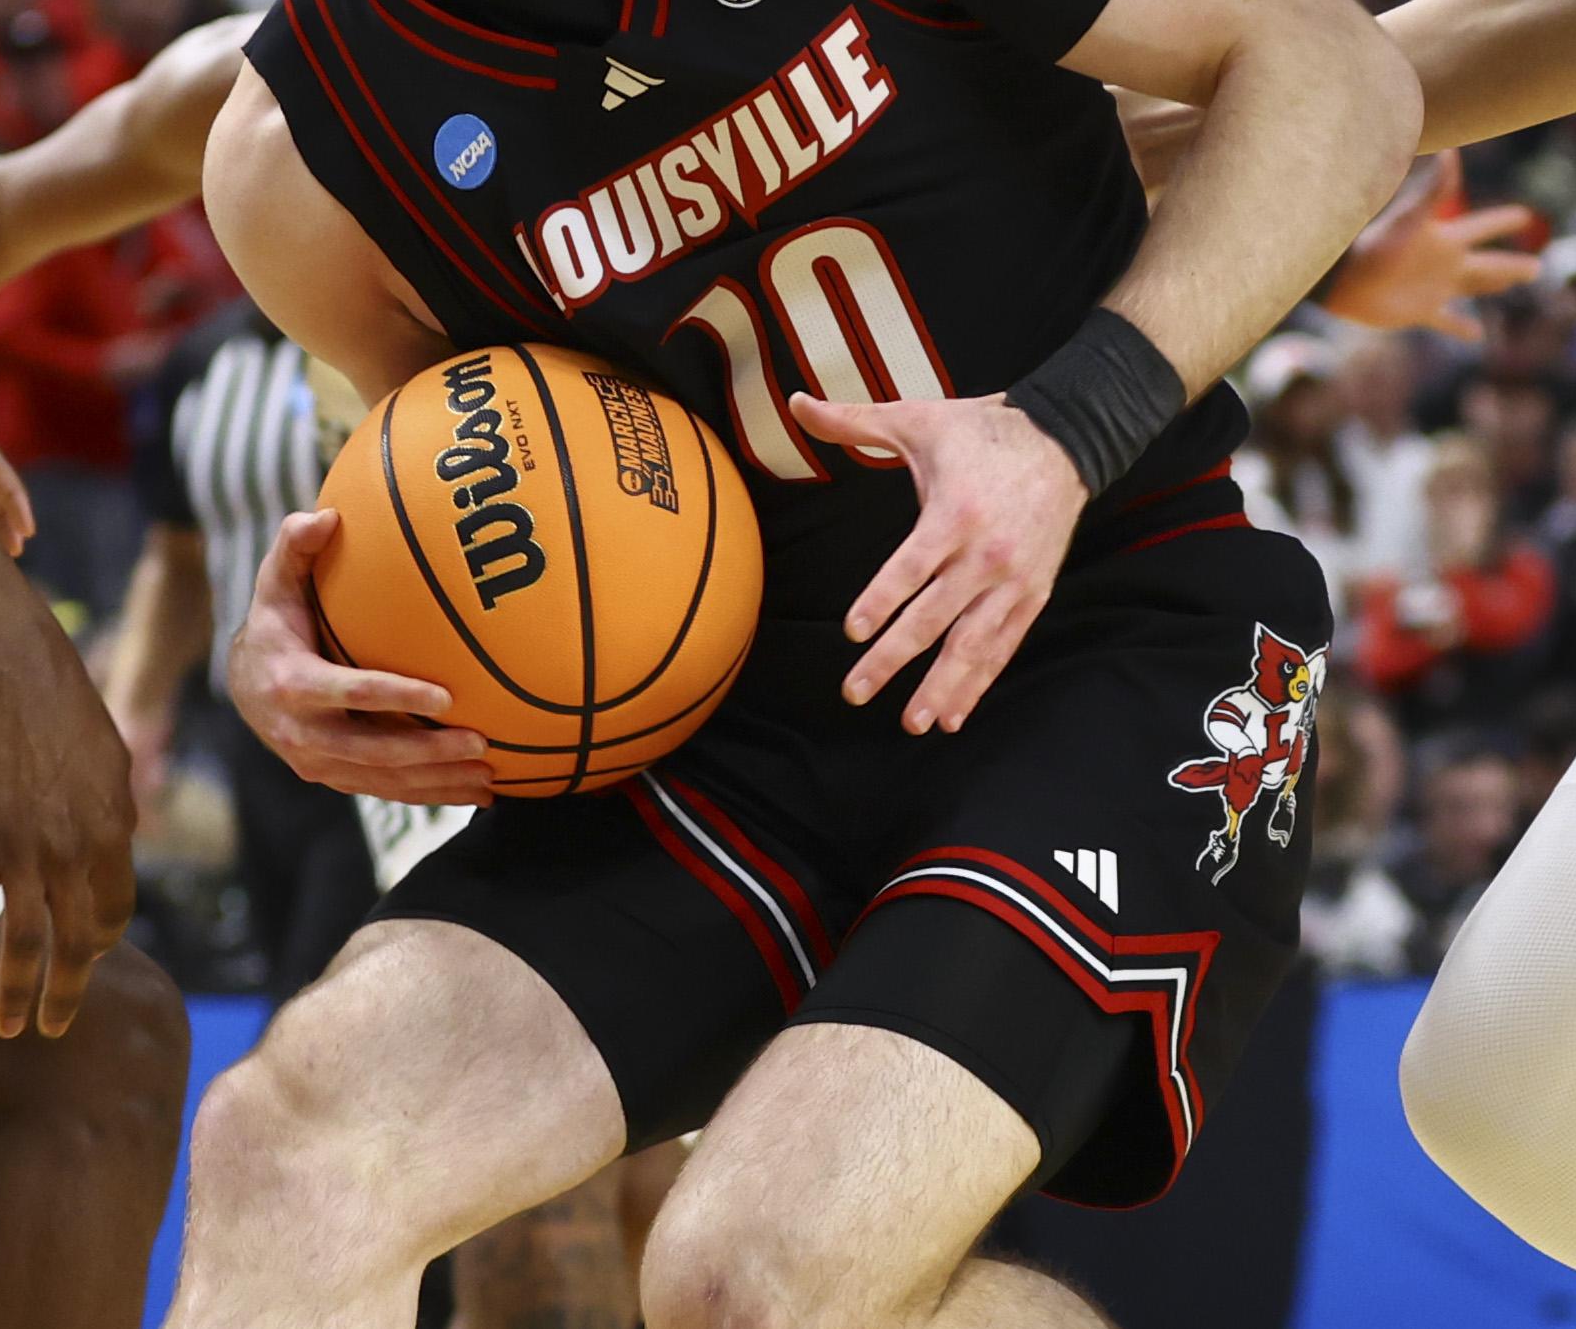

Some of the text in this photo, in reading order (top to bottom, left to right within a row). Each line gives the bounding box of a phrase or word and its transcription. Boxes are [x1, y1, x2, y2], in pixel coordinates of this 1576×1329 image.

[448, 131, 493, 182] NCAA
[661, 217, 957, 483] 10
[505, 399, 536, 472] EVO NXT
[602, 398, 643, 471] MARCH
[434, 352, 548, 612] Wilson
